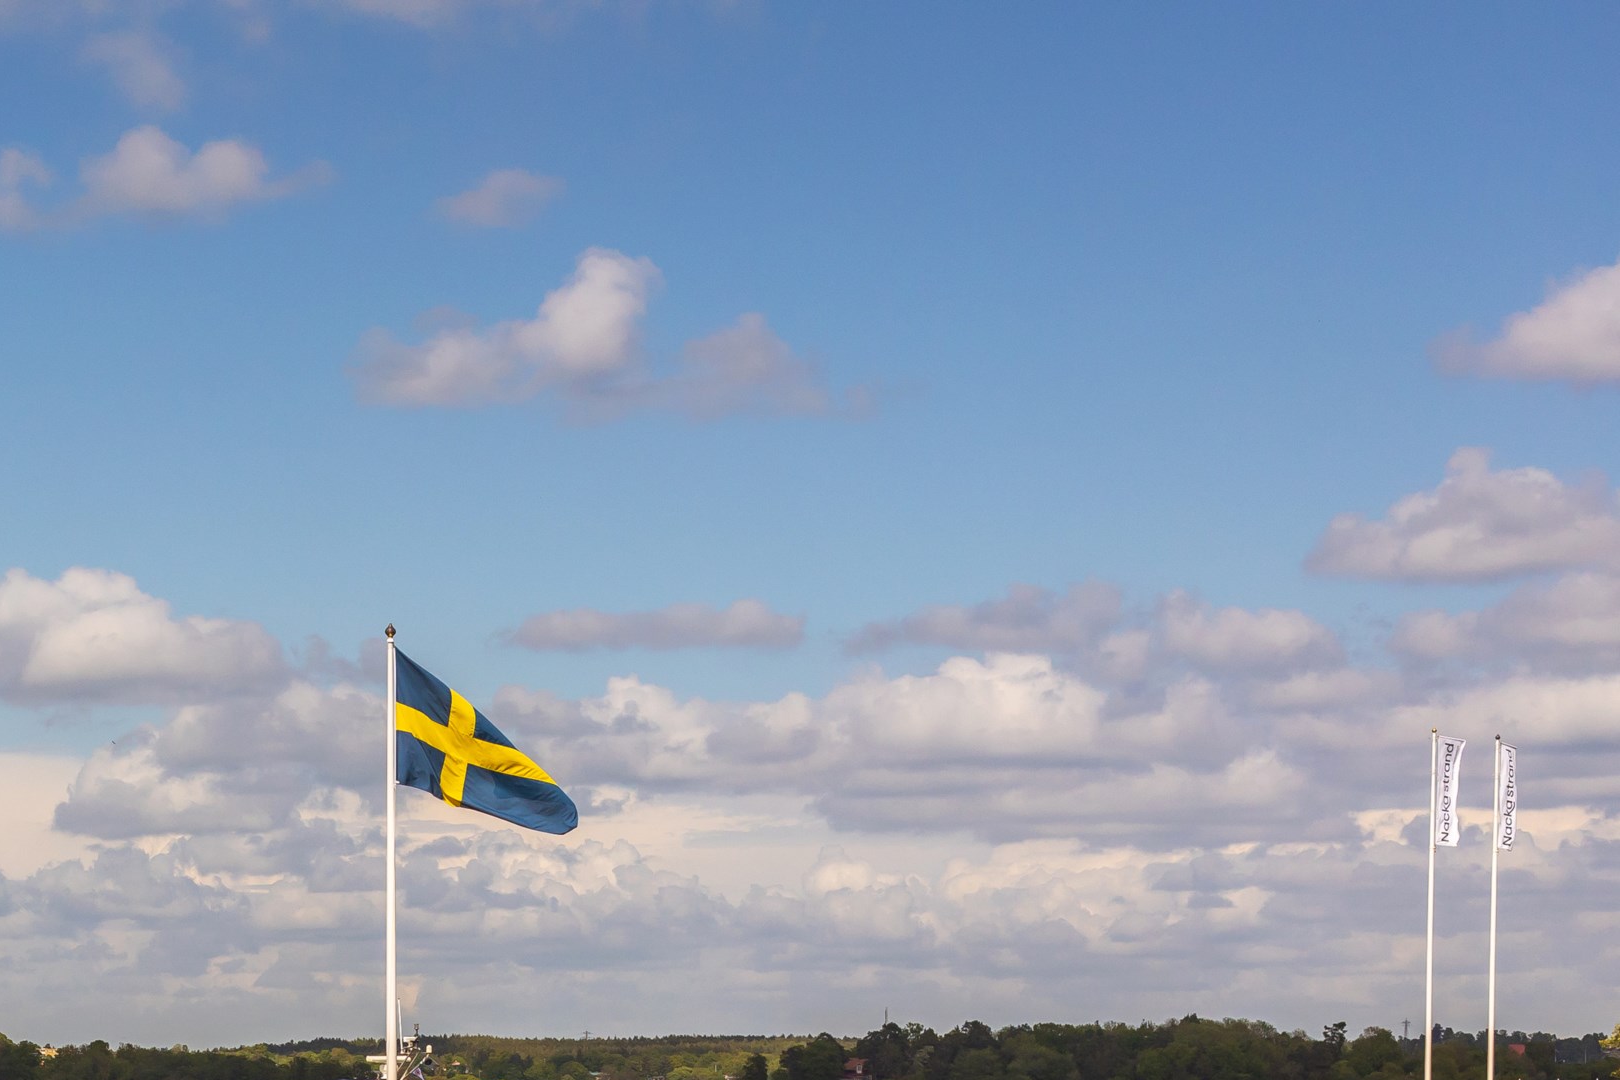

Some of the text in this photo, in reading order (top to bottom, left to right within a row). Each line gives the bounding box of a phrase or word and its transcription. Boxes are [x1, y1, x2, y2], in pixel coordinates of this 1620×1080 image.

[1441, 743, 1454, 842] Nacka strand
[1502, 800, 1515, 847] Nacka
